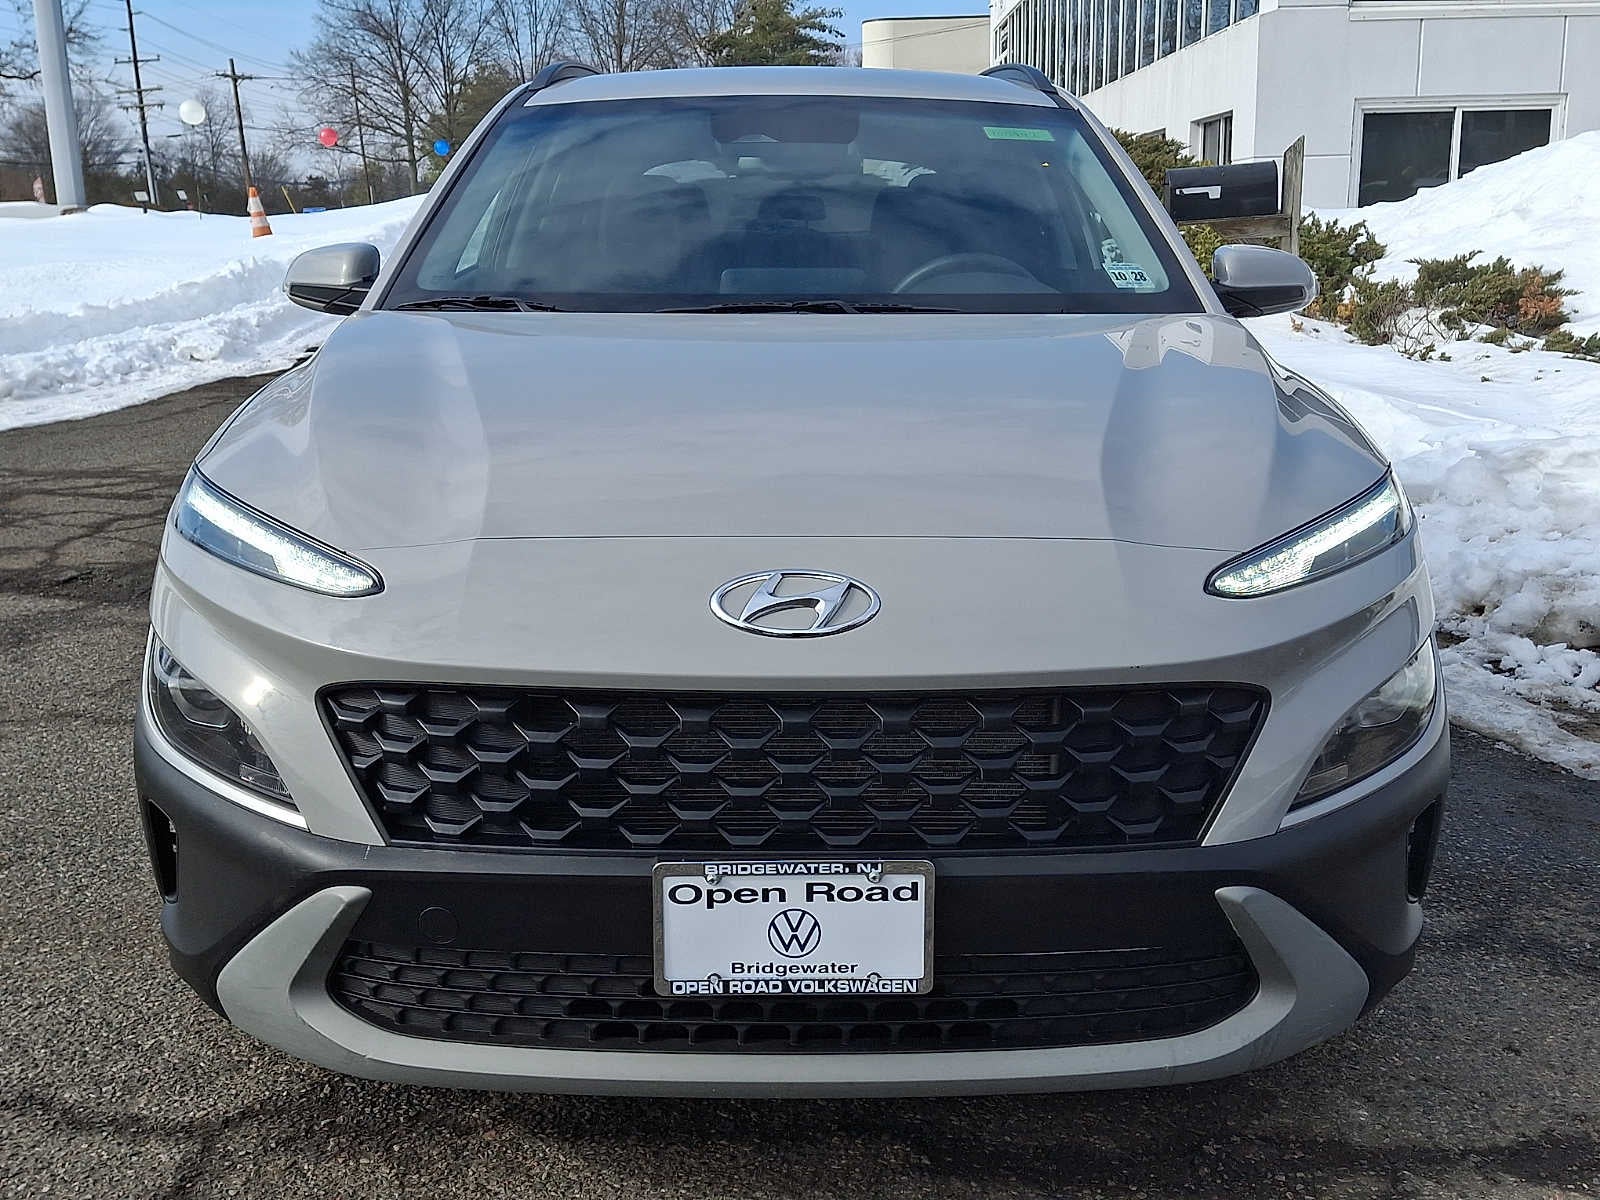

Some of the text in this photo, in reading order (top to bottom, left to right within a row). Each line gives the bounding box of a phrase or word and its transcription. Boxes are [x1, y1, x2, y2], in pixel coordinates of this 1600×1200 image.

[1111, 271, 1147, 282] 10 28
[857, 863, 882, 874] NJ
[668, 881, 919, 910] Open Road
[731, 962, 859, 976] Bridgewater
[672, 979, 917, 995] OPEN ROAD VOLKSWAGEN
